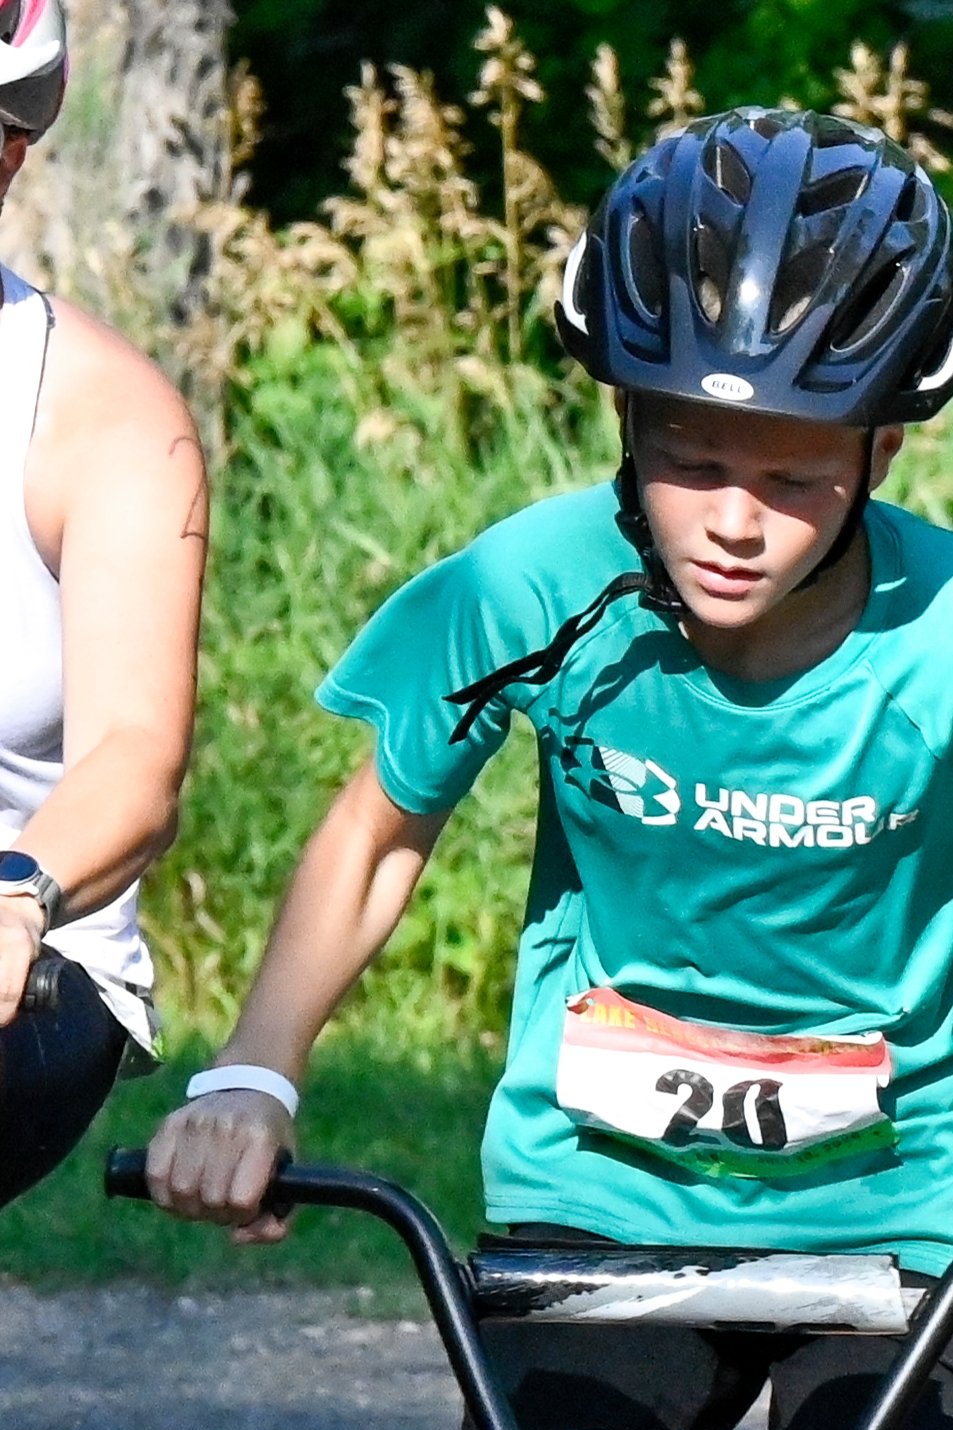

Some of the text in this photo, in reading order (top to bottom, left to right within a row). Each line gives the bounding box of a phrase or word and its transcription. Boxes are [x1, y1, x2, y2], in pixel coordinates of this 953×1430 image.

[711, 380, 742, 394] BELL
[695, 783, 876, 826] UNDER
[655, 1068, 788, 1150] 20
